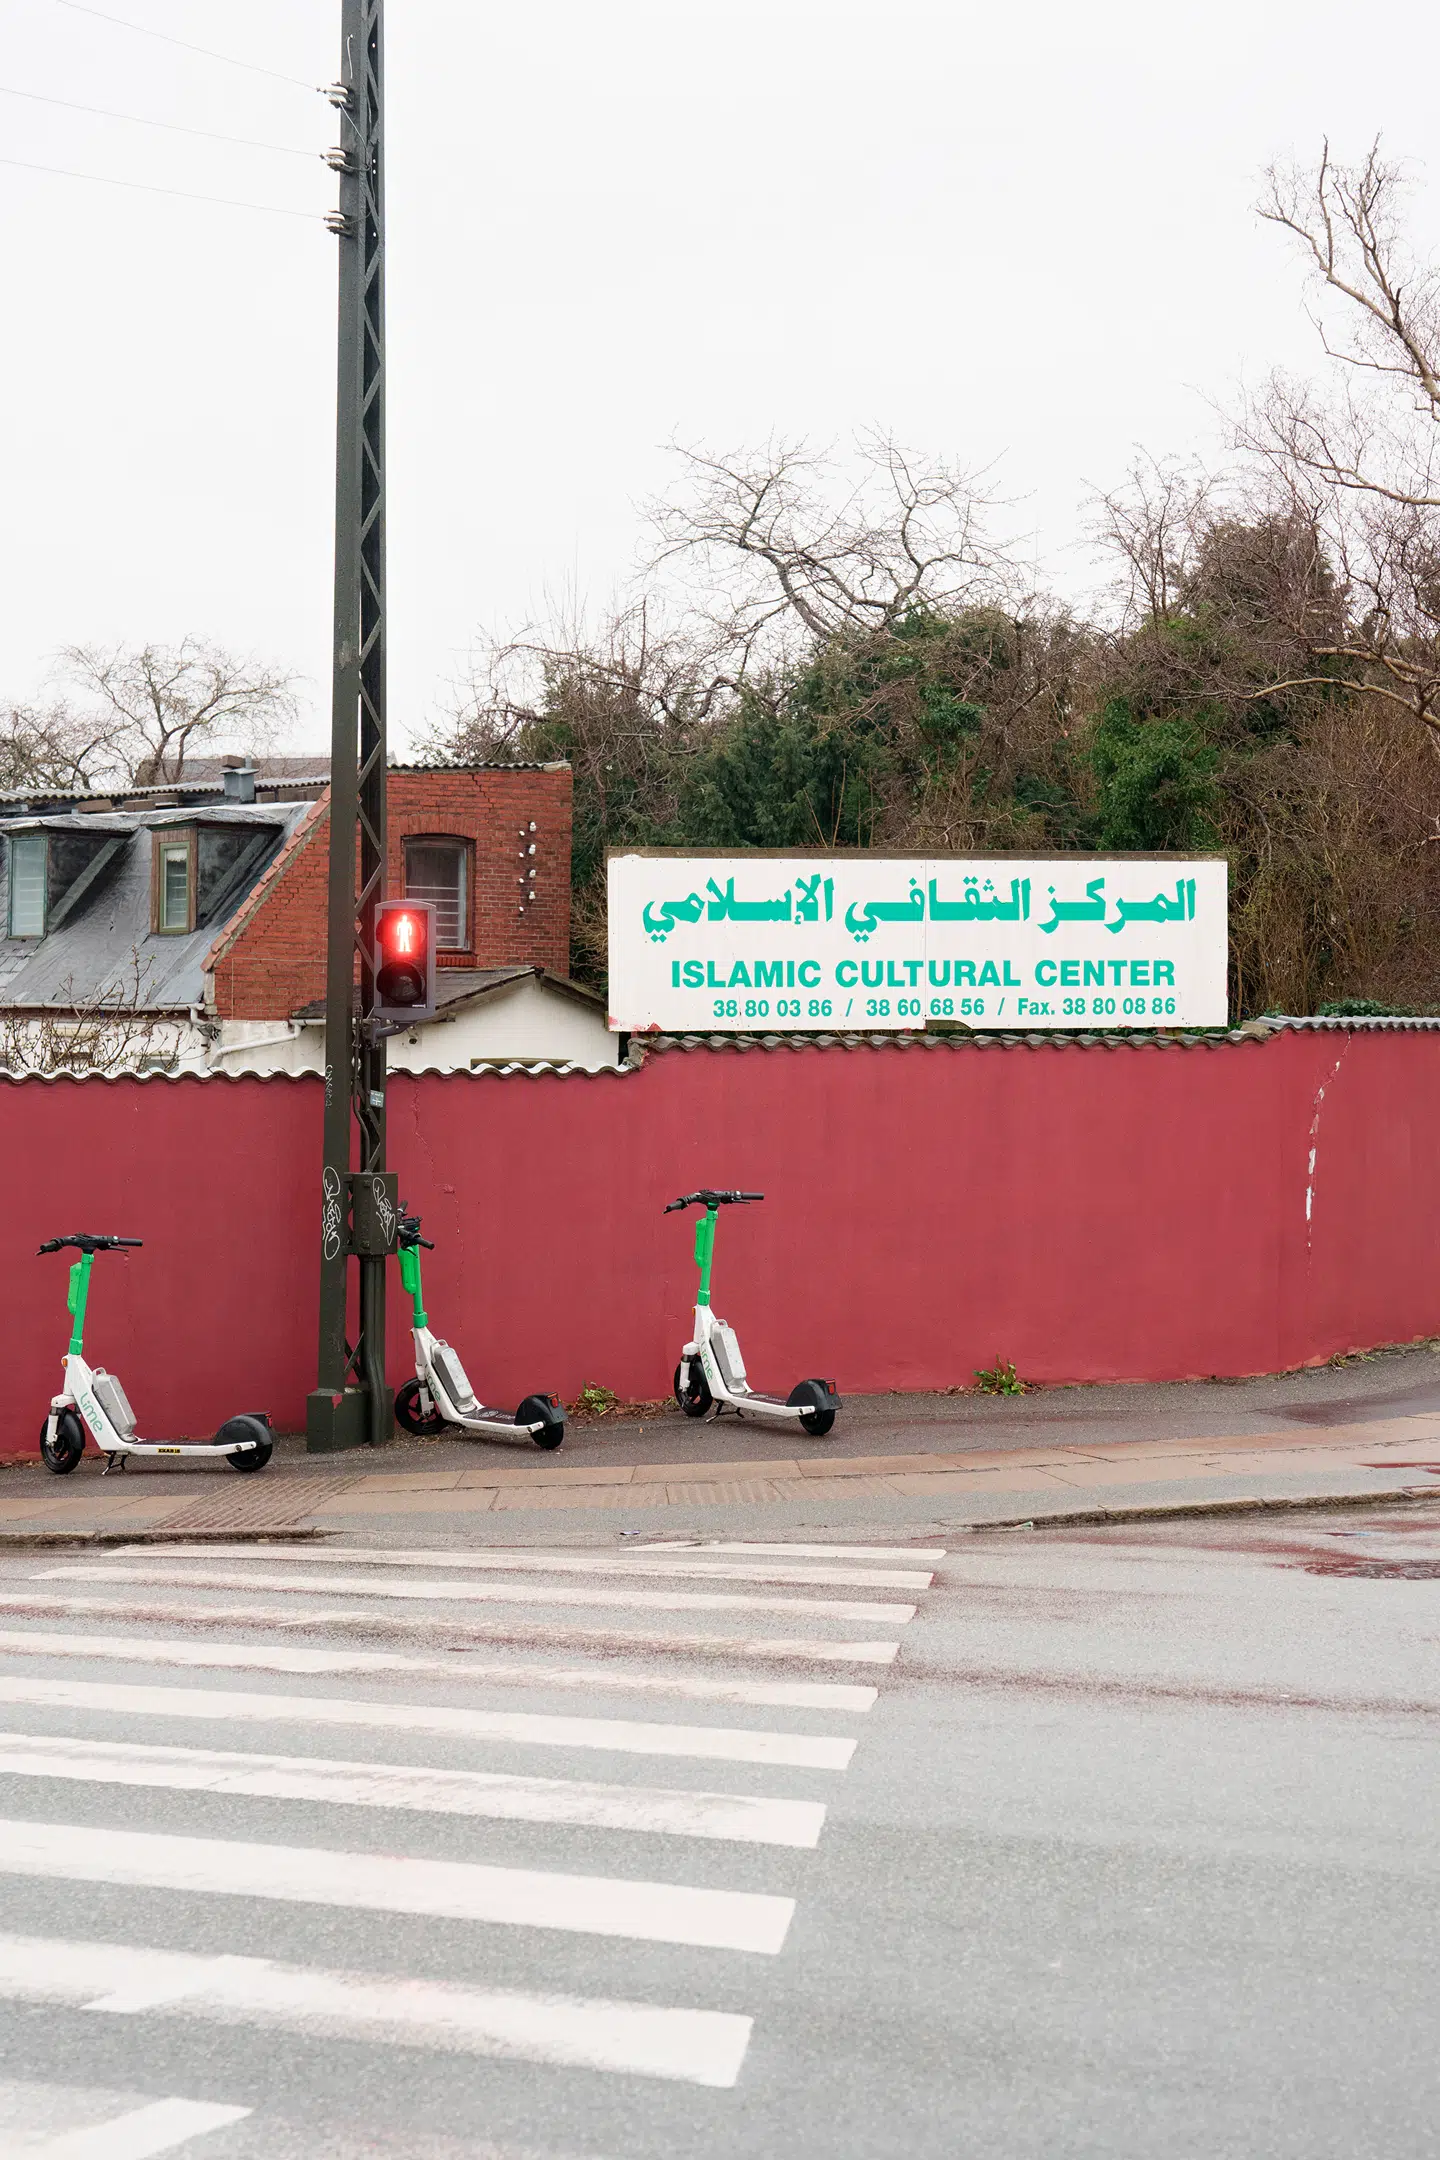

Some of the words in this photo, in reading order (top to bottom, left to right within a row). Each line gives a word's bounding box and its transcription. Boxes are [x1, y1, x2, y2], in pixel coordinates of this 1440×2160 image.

[642, 873, 834, 943] الإسلامي
[844, 876, 1031, 943] الثقافي
[1037, 877, 1196, 934] المركز
[671, 960, 822, 989] ISLAMIC
[834, 960, 1021, 989] CULTURAL
[1035, 960, 1175, 988] CENTER
[714, 1000, 738, 1017] 38
[745, 1000, 770, 1018] 80
[777, 1000, 800, 1017] 03
[808, 1000, 832, 1017] 86
[846, 998, 853, 1017] /
[866, 999, 890, 1016] 38
[898, 999, 920, 1016] 60
[930, 998, 954, 1016] 68
[961, 998, 984, 1016] 56
[998, 998, 1005, 1015] /
[1018, 998, 1055, 1015] Fax.
[1062, 998, 1086, 1015] 38
[1092, 998, 1116, 1015] 80
[1122, 998, 1146, 1015] 08
[1152, 997, 1176, 1015] 86
[80, 1392, 103, 1432] Lime
